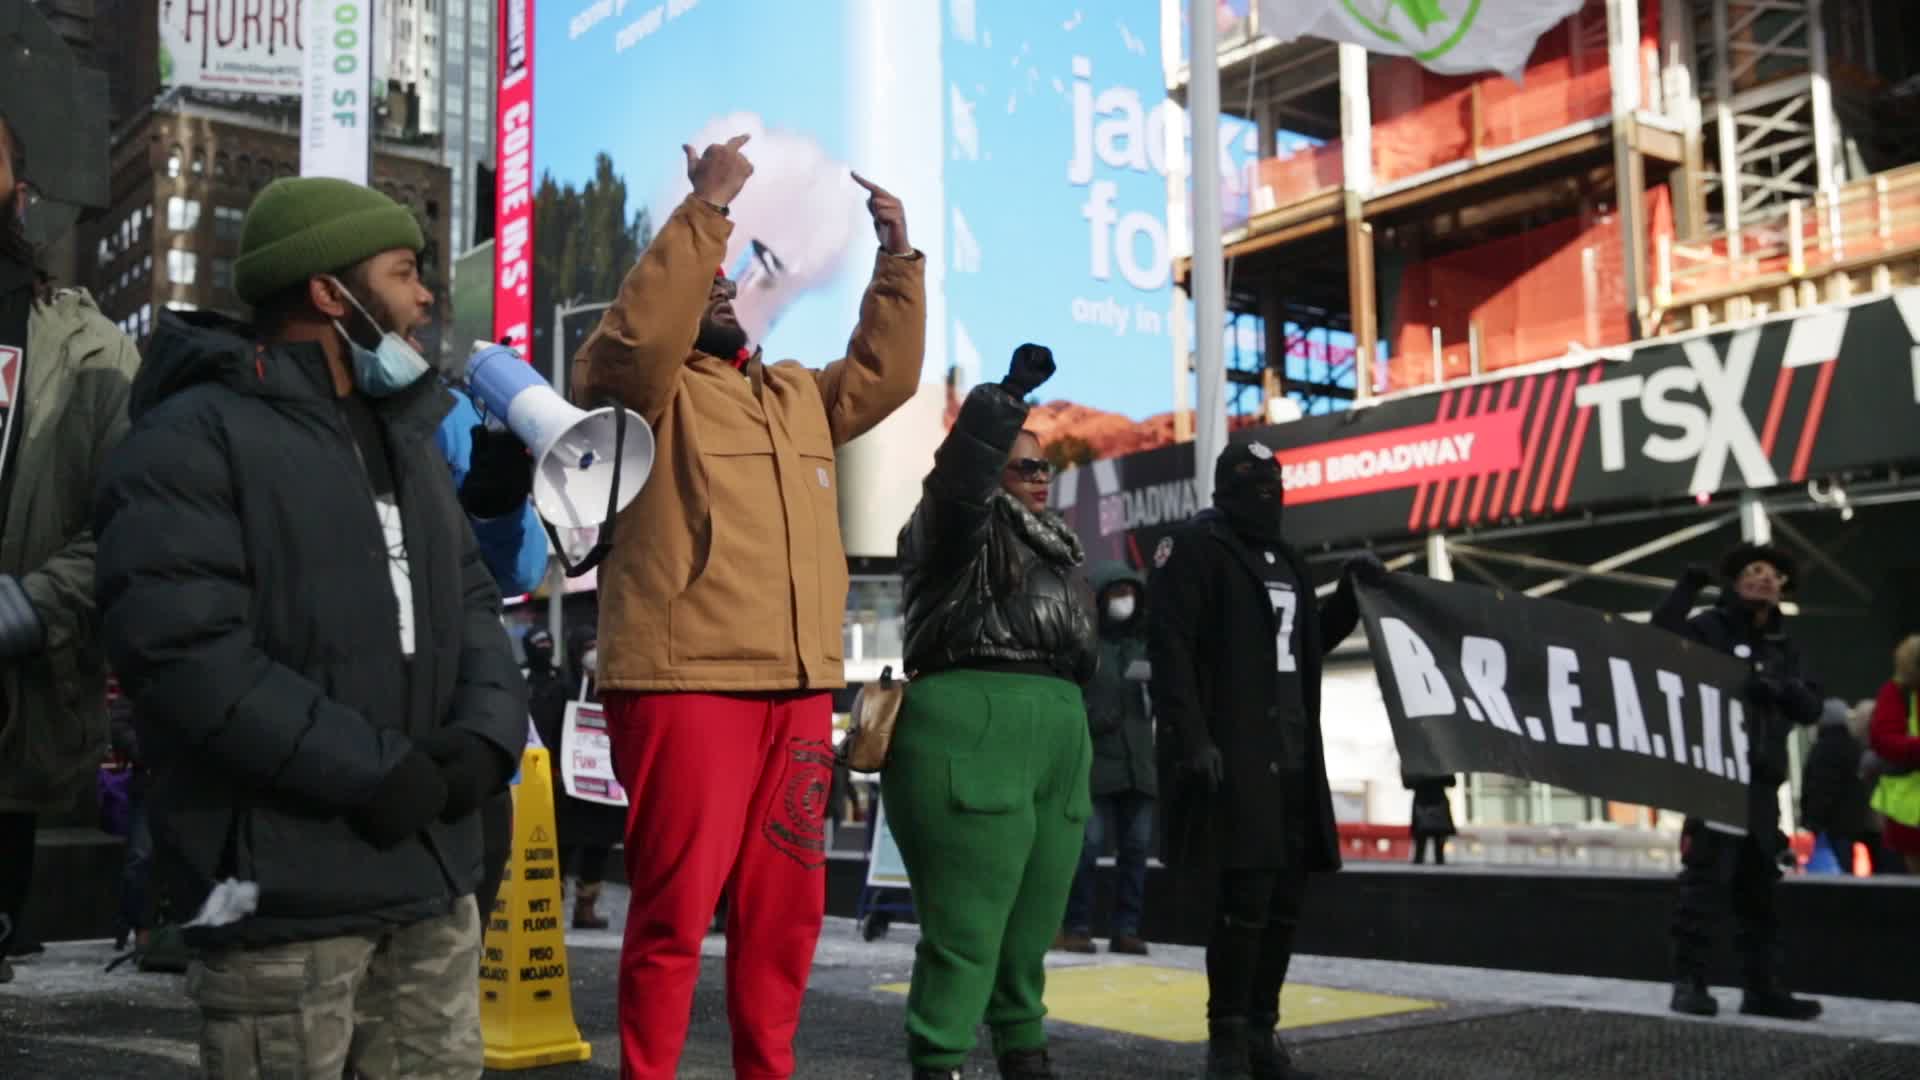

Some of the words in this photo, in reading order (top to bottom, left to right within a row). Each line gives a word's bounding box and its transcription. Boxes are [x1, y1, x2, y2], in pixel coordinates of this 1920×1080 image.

[503, 99, 530, 216] COME
[1082, 180, 1171, 291] fo
[1072, 297, 1128, 337] only
[1136, 302, 1161, 334] in
[1575, 322, 1779, 496] TSX
[1326, 432, 1475, 483] BROADWAY
[1268, 588, 1297, 672] 7
[523, 916, 558, 932] FLOOR
[528, 898, 551, 913] WET
[519, 963, 564, 981] MOJADO
[529, 946, 553, 962] PISO
